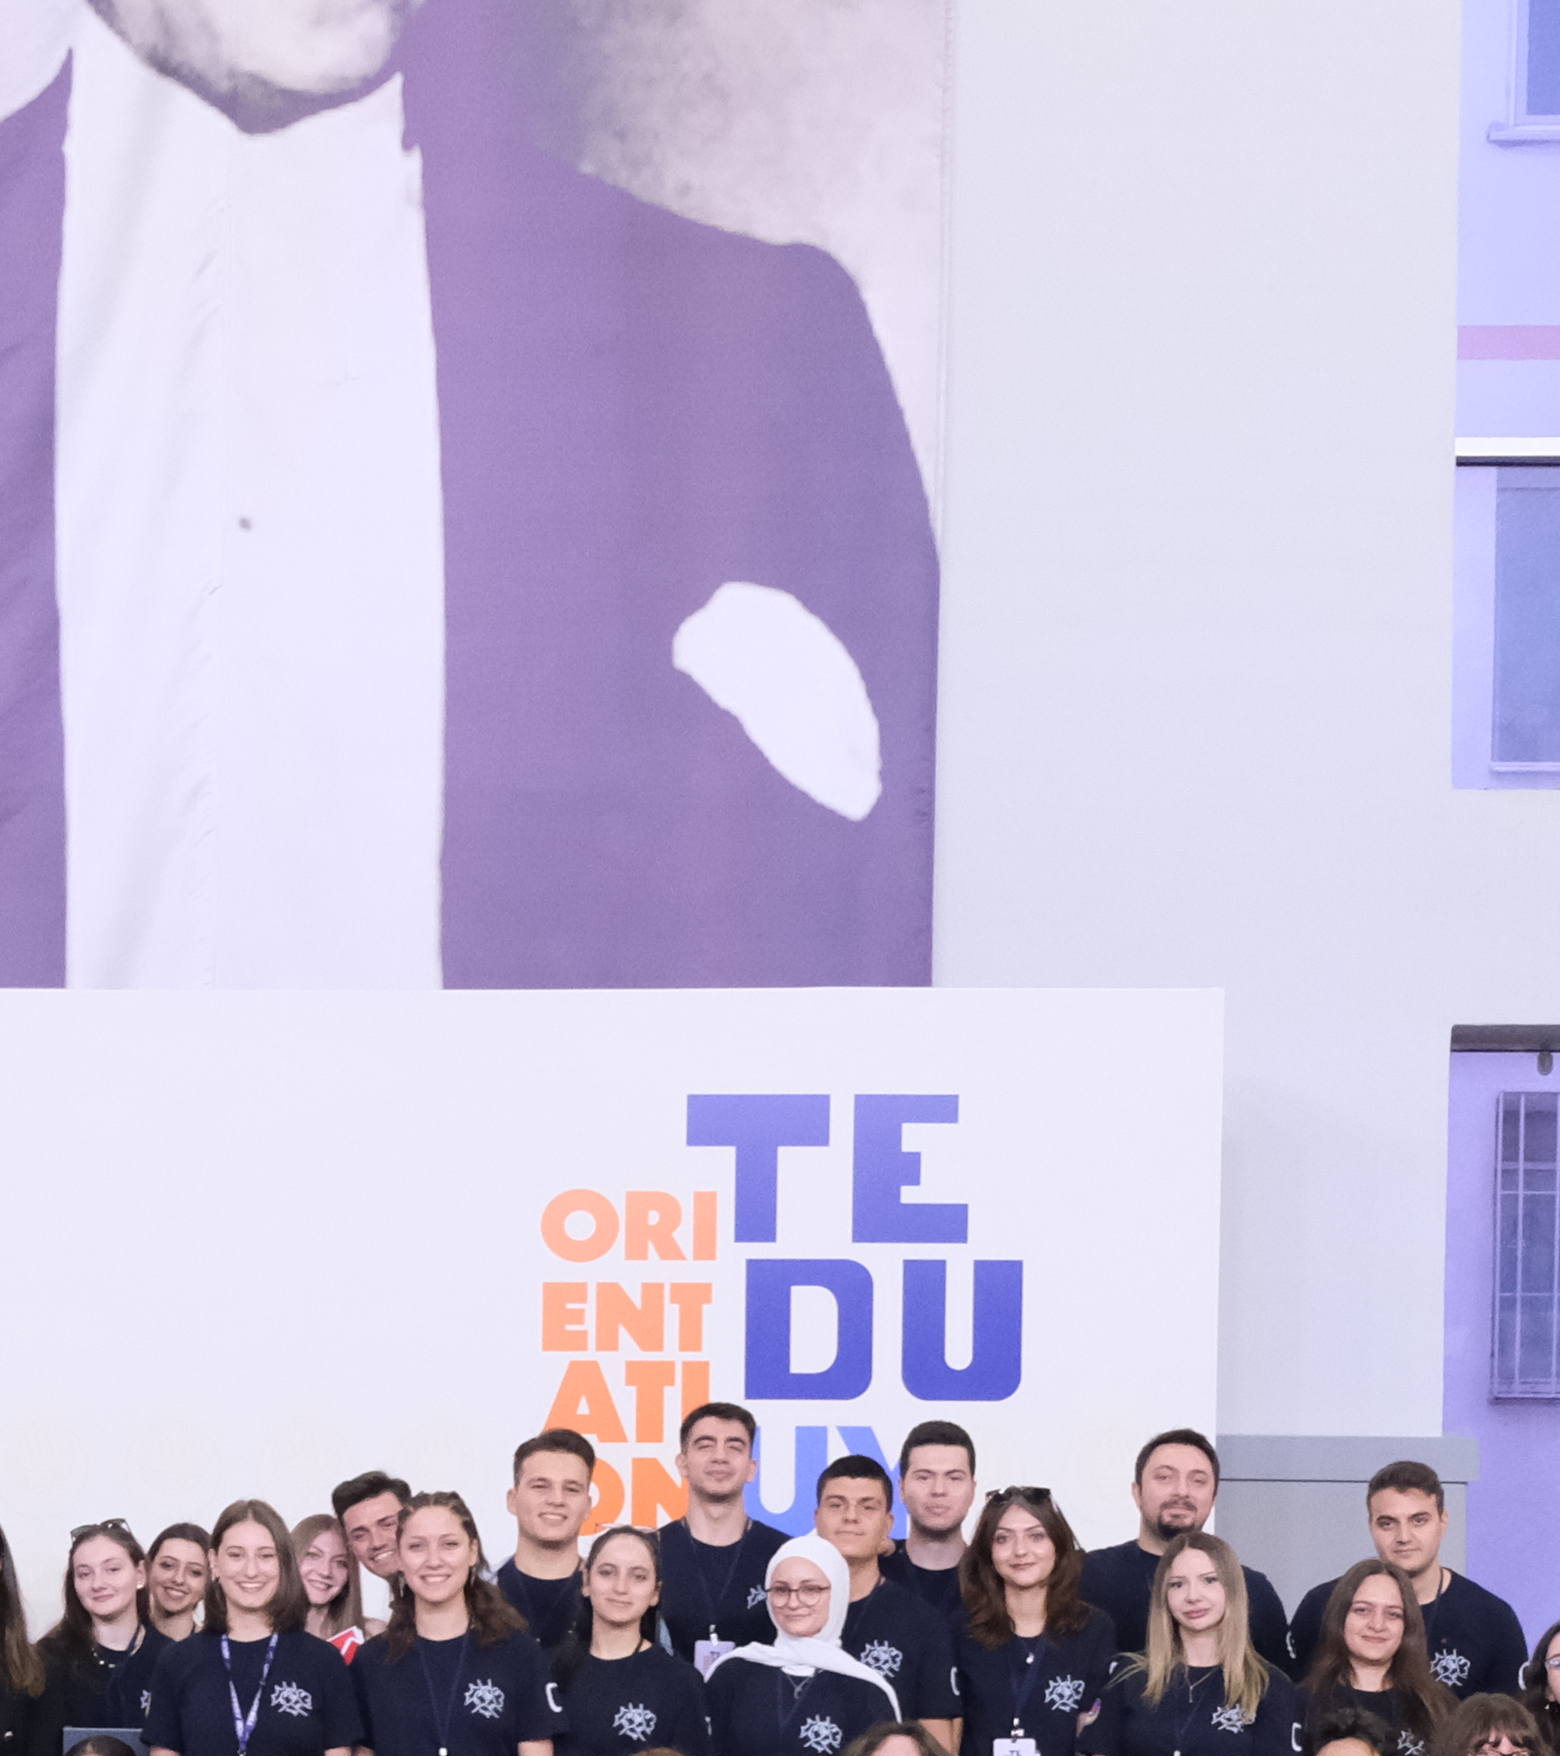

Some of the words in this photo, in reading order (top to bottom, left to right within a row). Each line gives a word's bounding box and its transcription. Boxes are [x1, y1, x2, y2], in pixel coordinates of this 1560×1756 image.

[686, 1094, 968, 1243] TE
[541, 1188, 717, 1262] ORI
[542, 1282, 712, 1352] ENT
[745, 1258, 1023, 1401] DU
